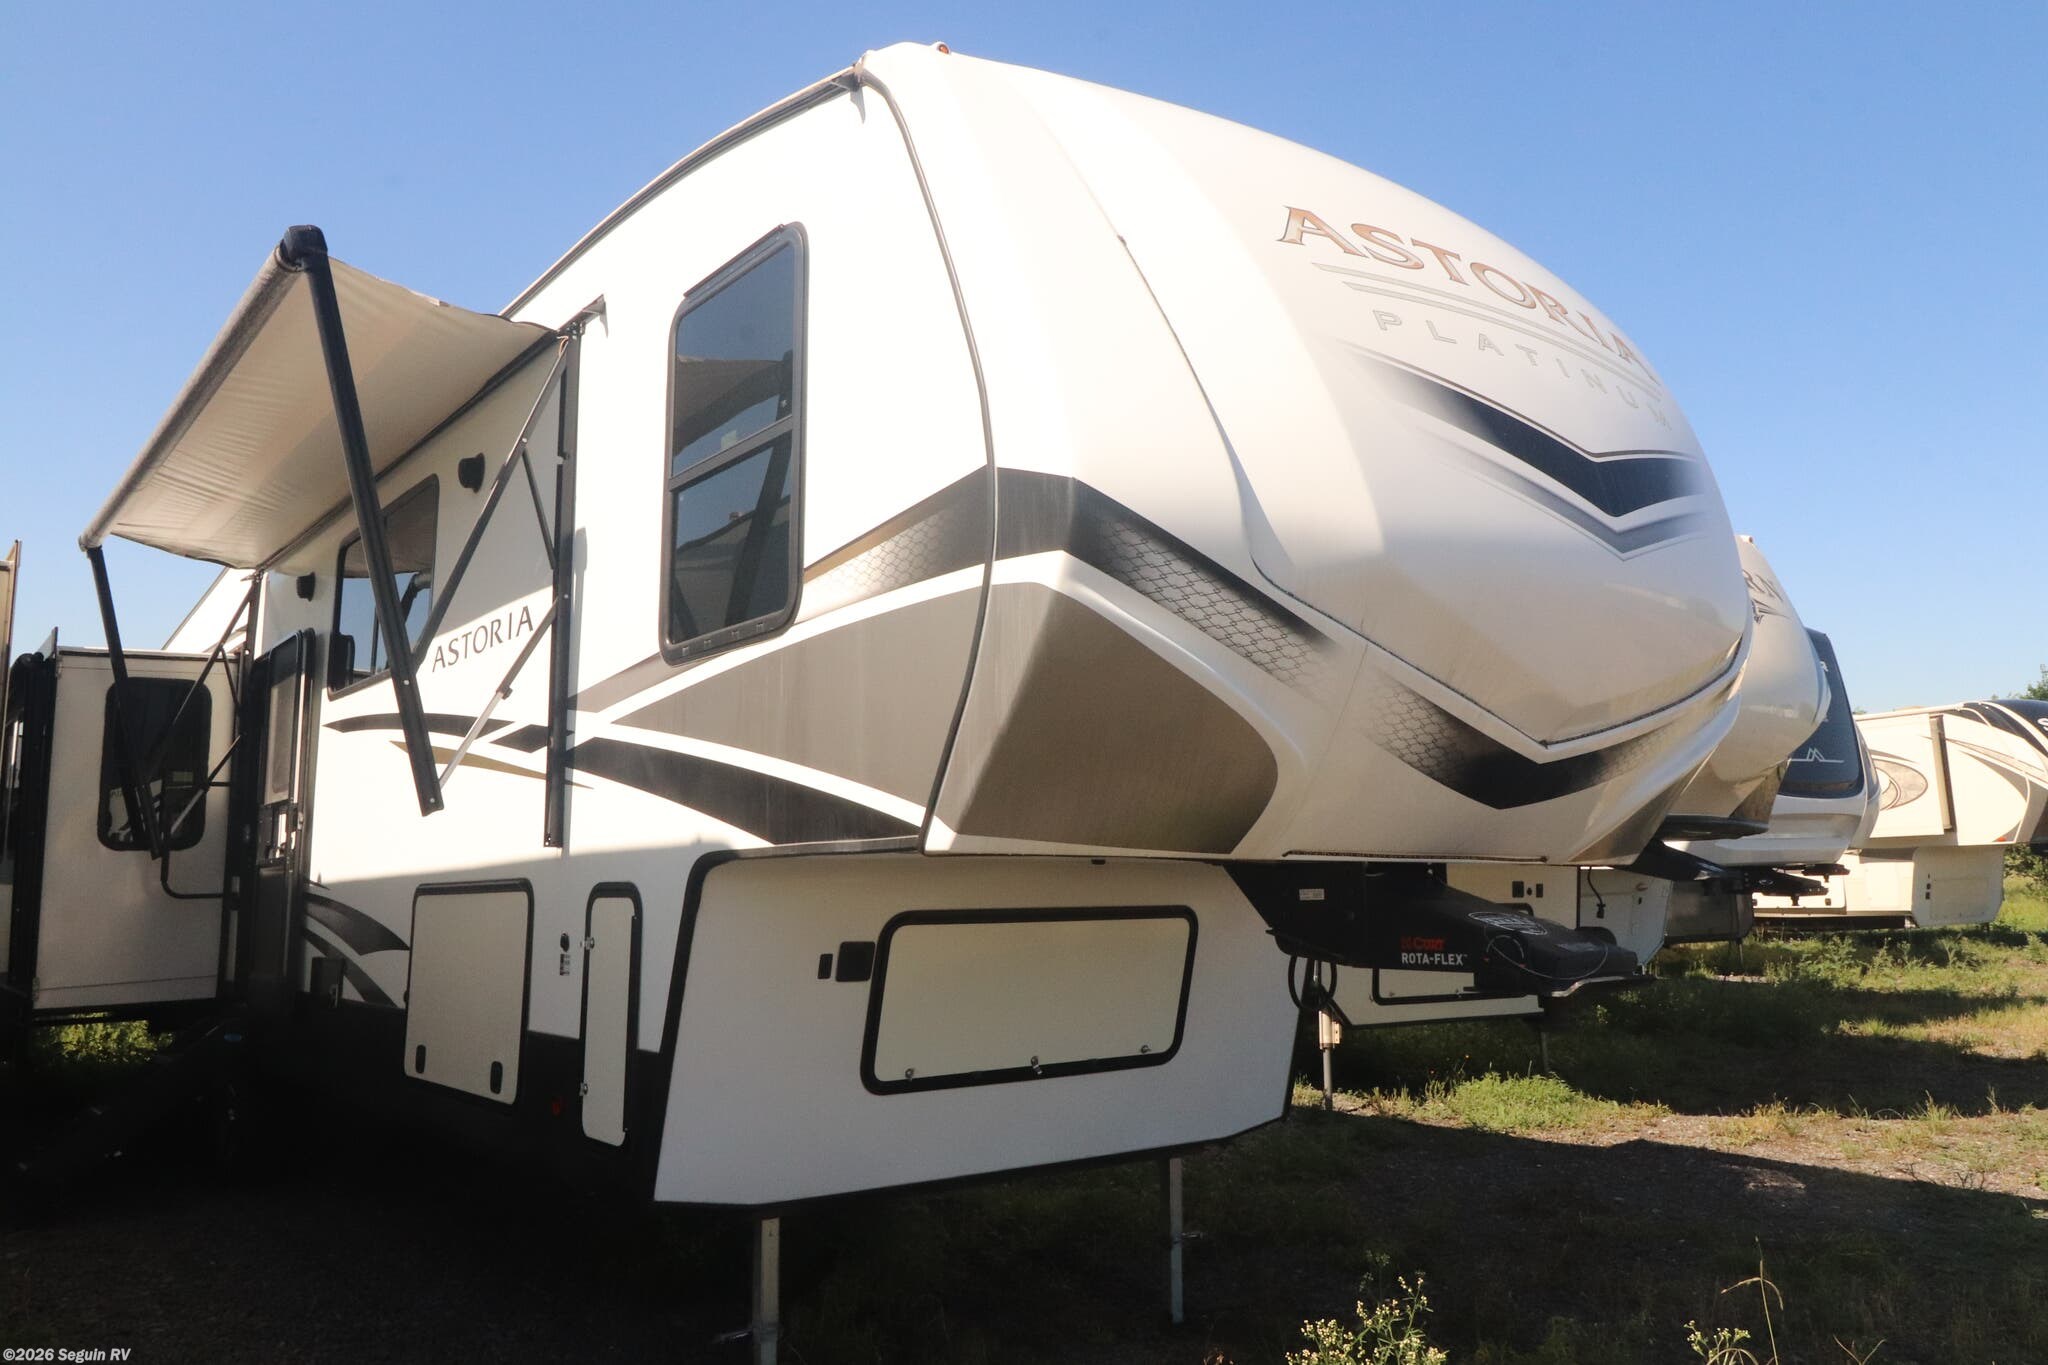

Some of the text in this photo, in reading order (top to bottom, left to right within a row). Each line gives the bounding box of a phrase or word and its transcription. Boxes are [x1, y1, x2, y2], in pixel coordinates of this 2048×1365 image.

[1276, 205, 1661, 385] ASTORIA
[1372, 309, 1672, 431] PLATINUM
[432, 605, 534, 673] ASTORIA
